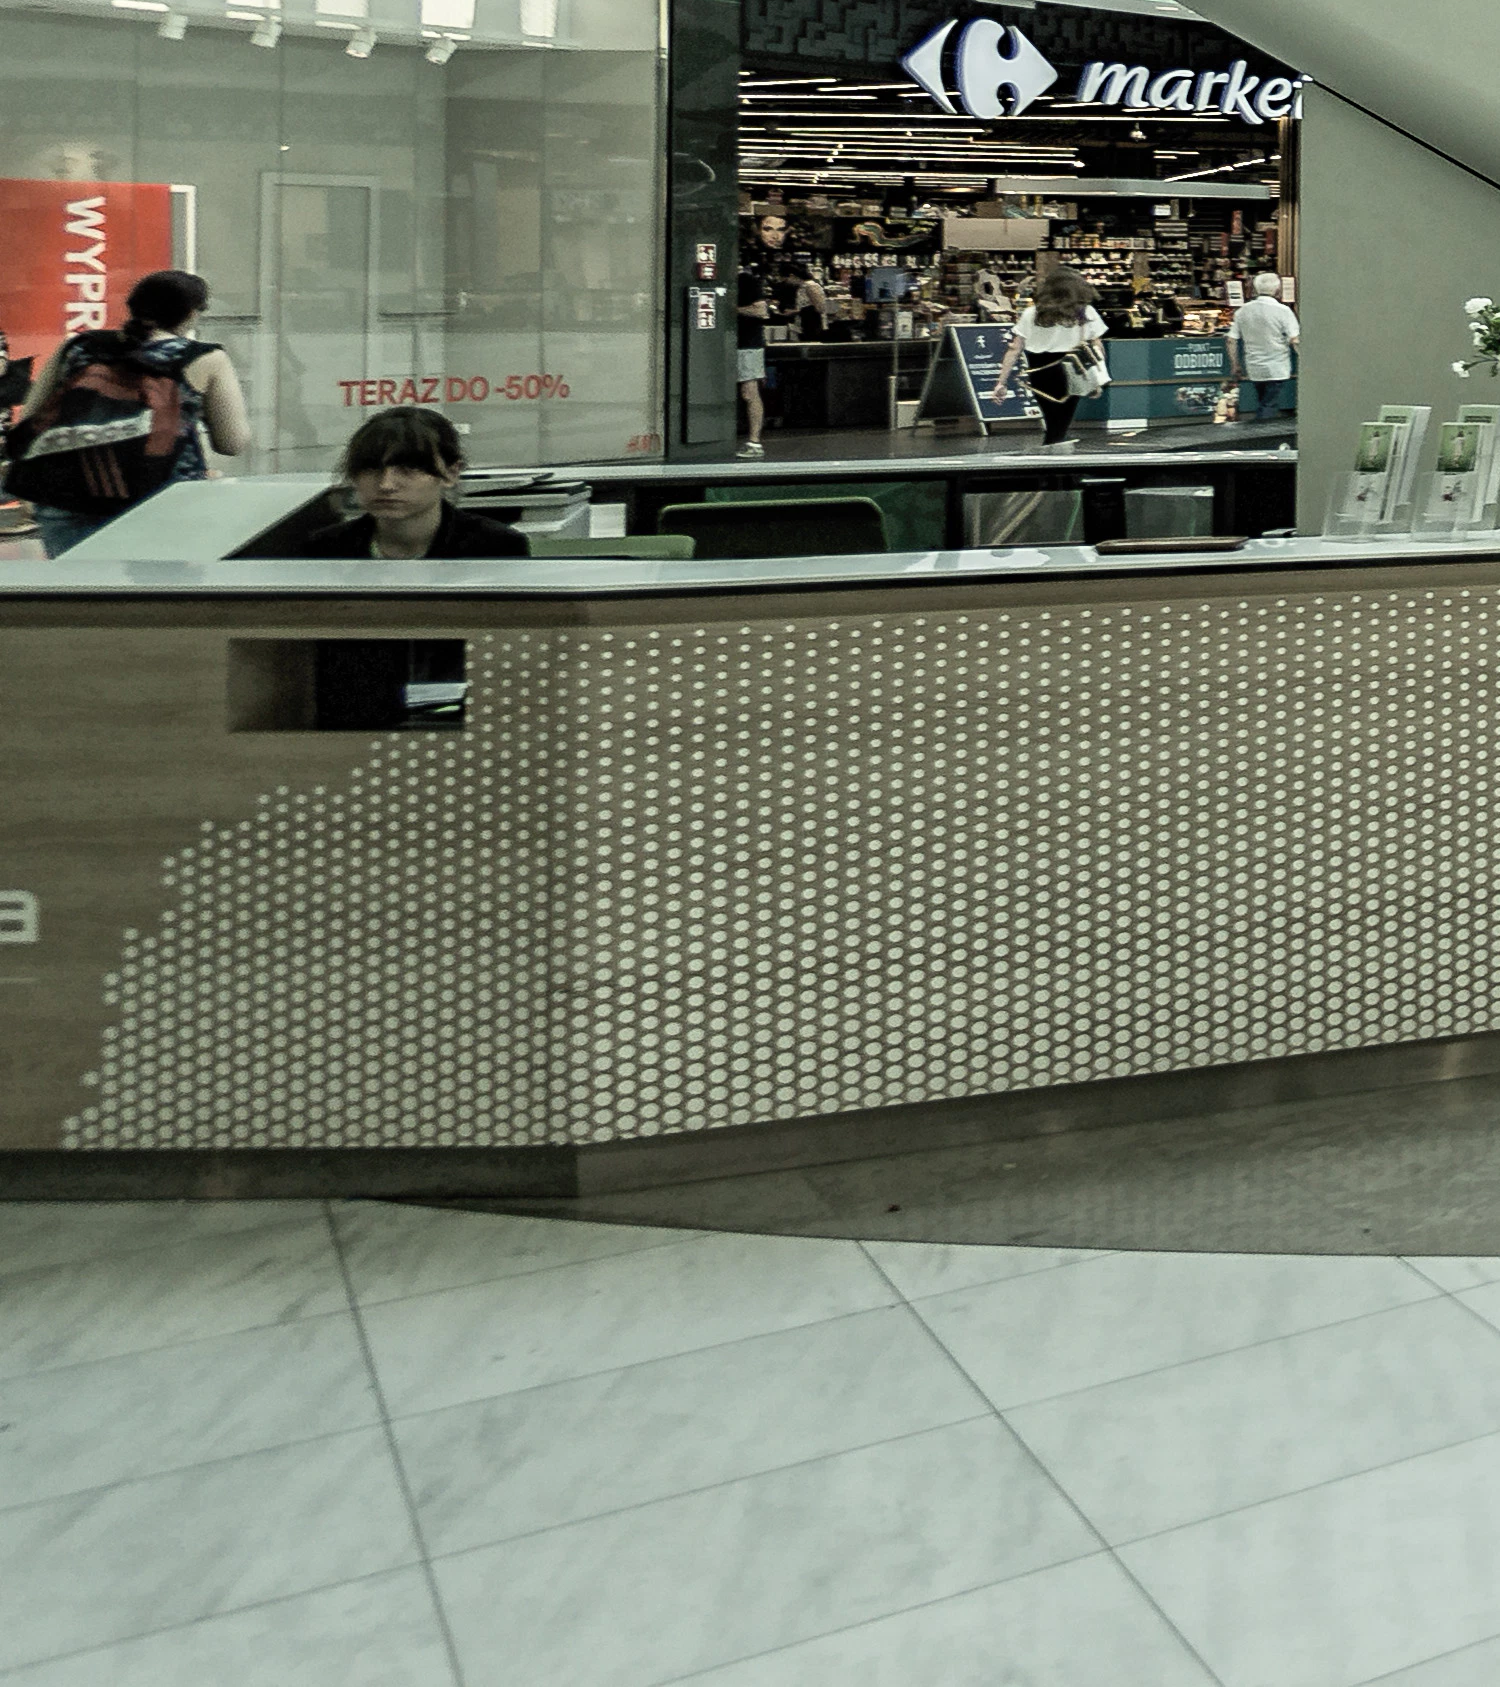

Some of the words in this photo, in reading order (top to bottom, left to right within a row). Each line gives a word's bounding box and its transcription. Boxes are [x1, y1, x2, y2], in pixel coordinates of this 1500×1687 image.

[338, 377, 440, 407] TERAZ
[446, 376, 490, 403] DO
[494, 373, 571, 401] -50%
